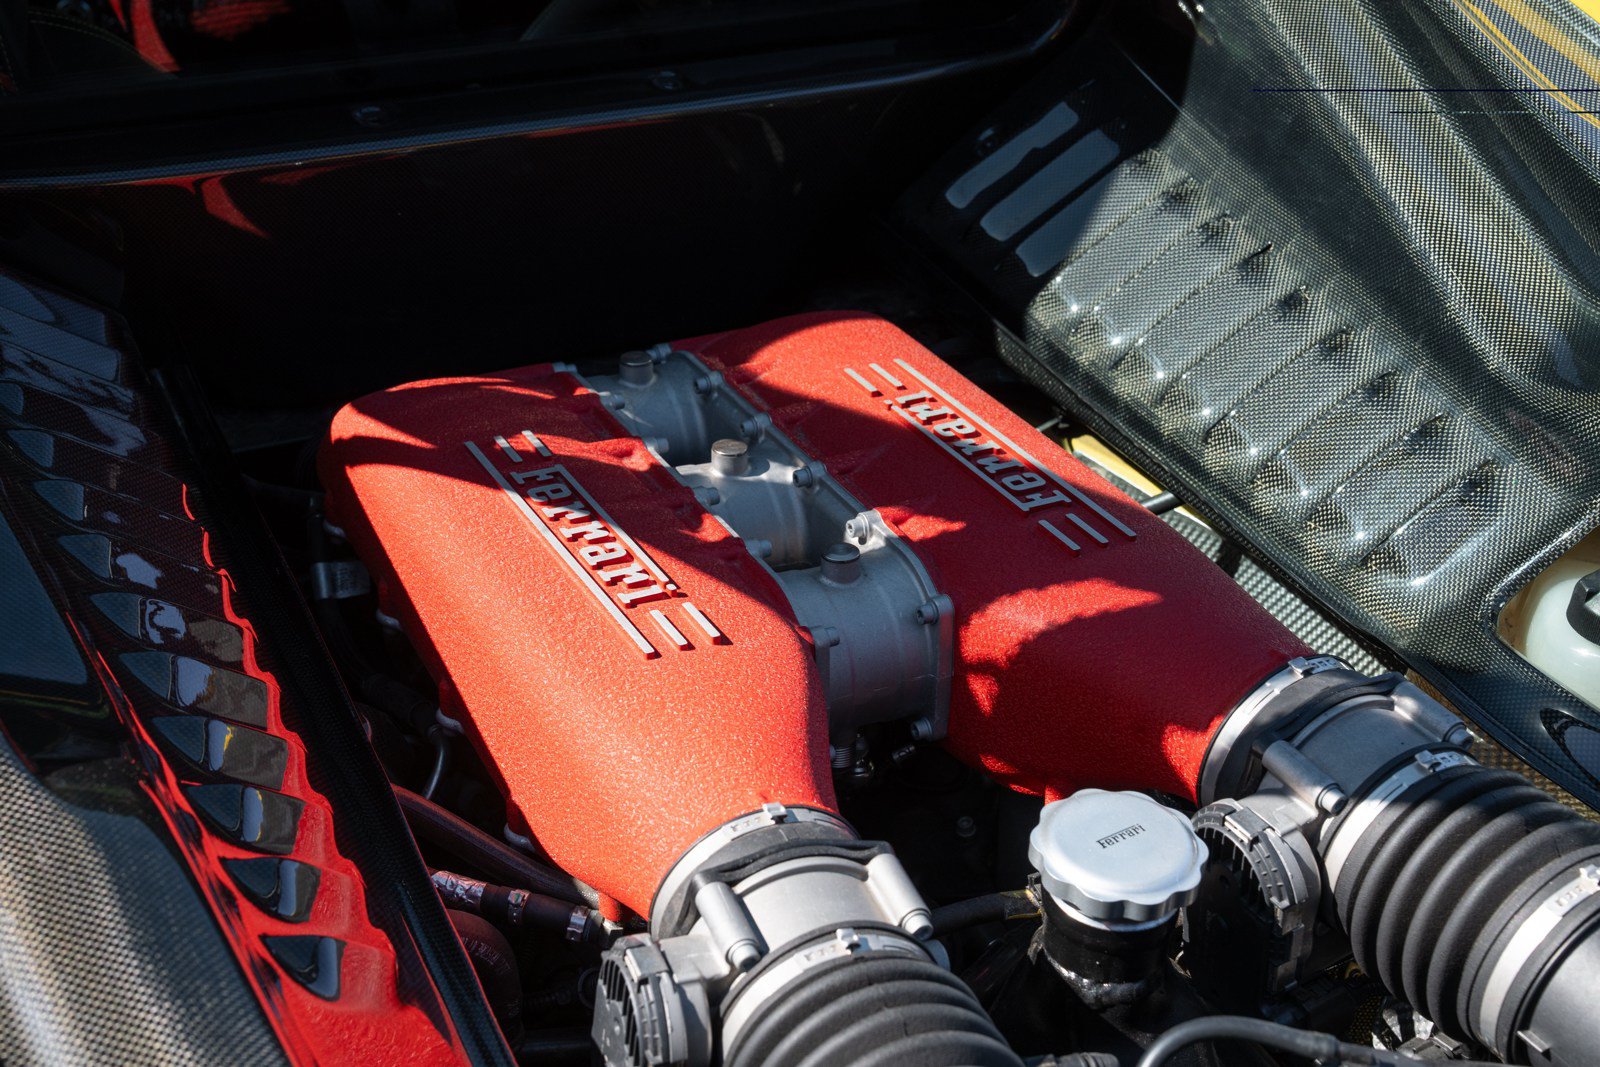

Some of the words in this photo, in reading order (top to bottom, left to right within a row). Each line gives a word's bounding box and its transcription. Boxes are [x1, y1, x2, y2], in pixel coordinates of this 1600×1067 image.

[884, 390, 1072, 511] Ferrari
[510, 464, 677, 605] Ferrari
[1096, 823, 1146, 849] Ferrari
